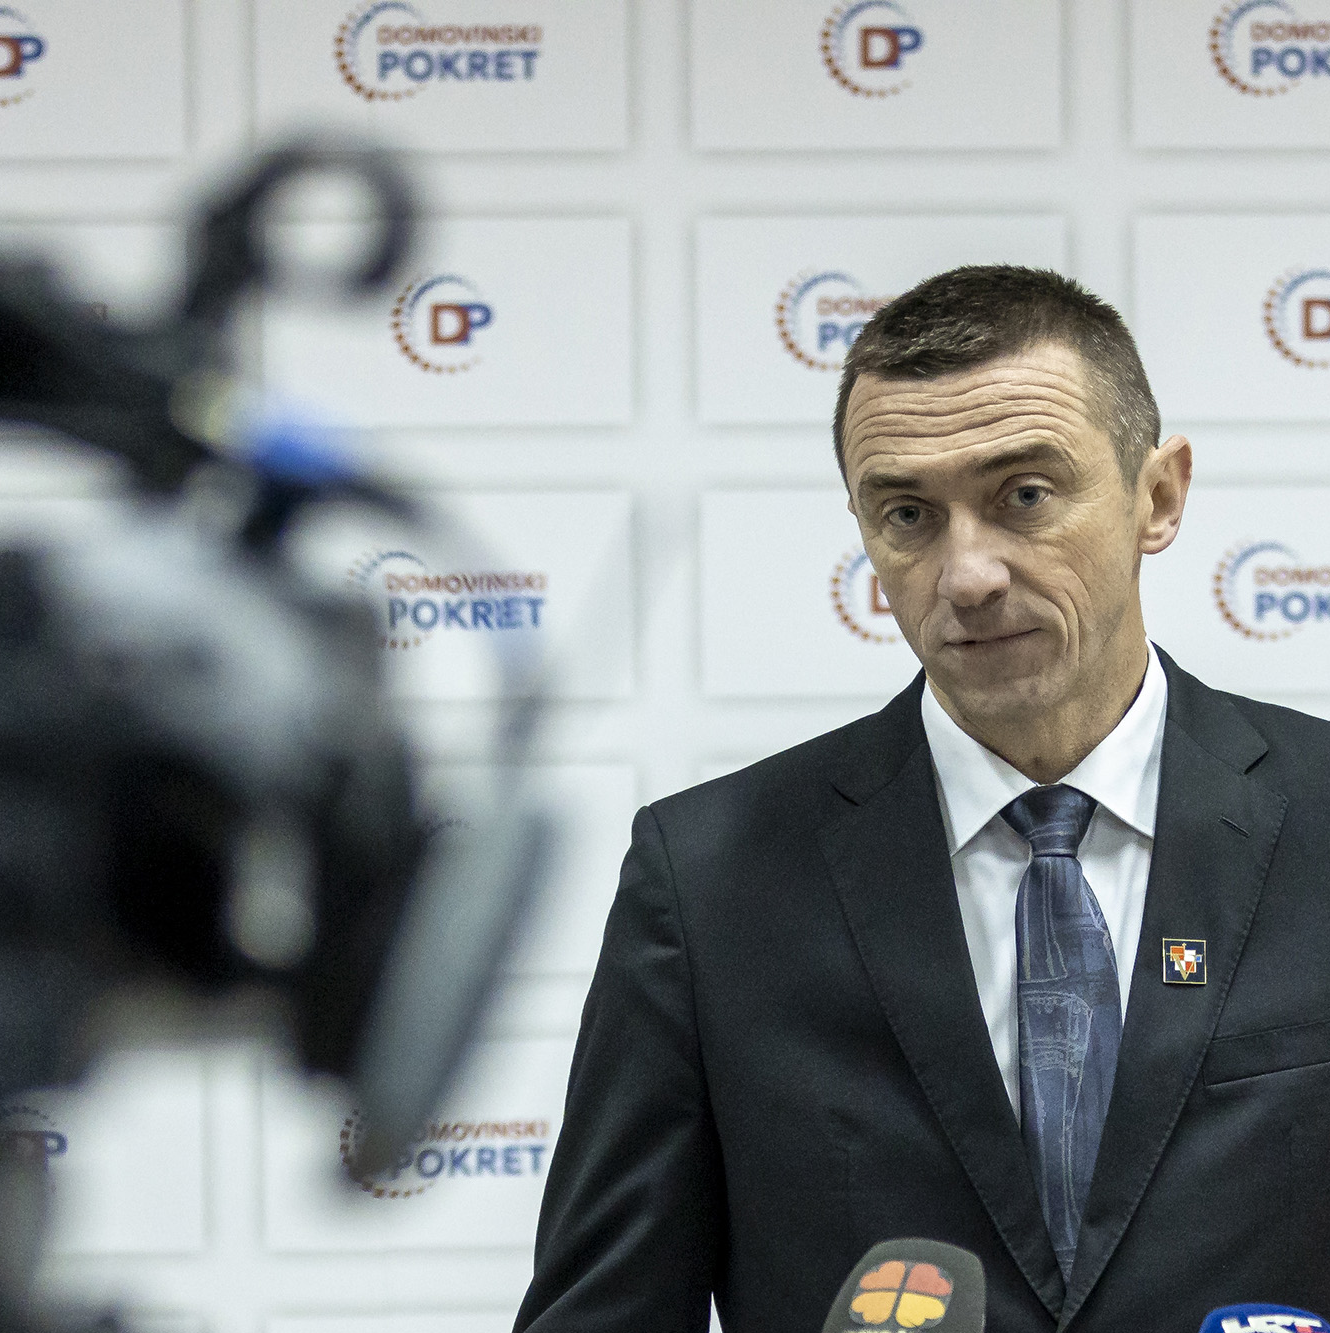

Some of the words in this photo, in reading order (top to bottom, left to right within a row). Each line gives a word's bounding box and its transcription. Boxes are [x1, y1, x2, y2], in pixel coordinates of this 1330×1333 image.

[377, 25, 542, 44] DOMOVINSKI
[859, 26, 924, 68] DP
[377, 50, 539, 81] POKRET
[430, 303, 495, 345] DP
[387, 597, 545, 631] POKRET
[426, 1120, 549, 1141] MOVINSKI
